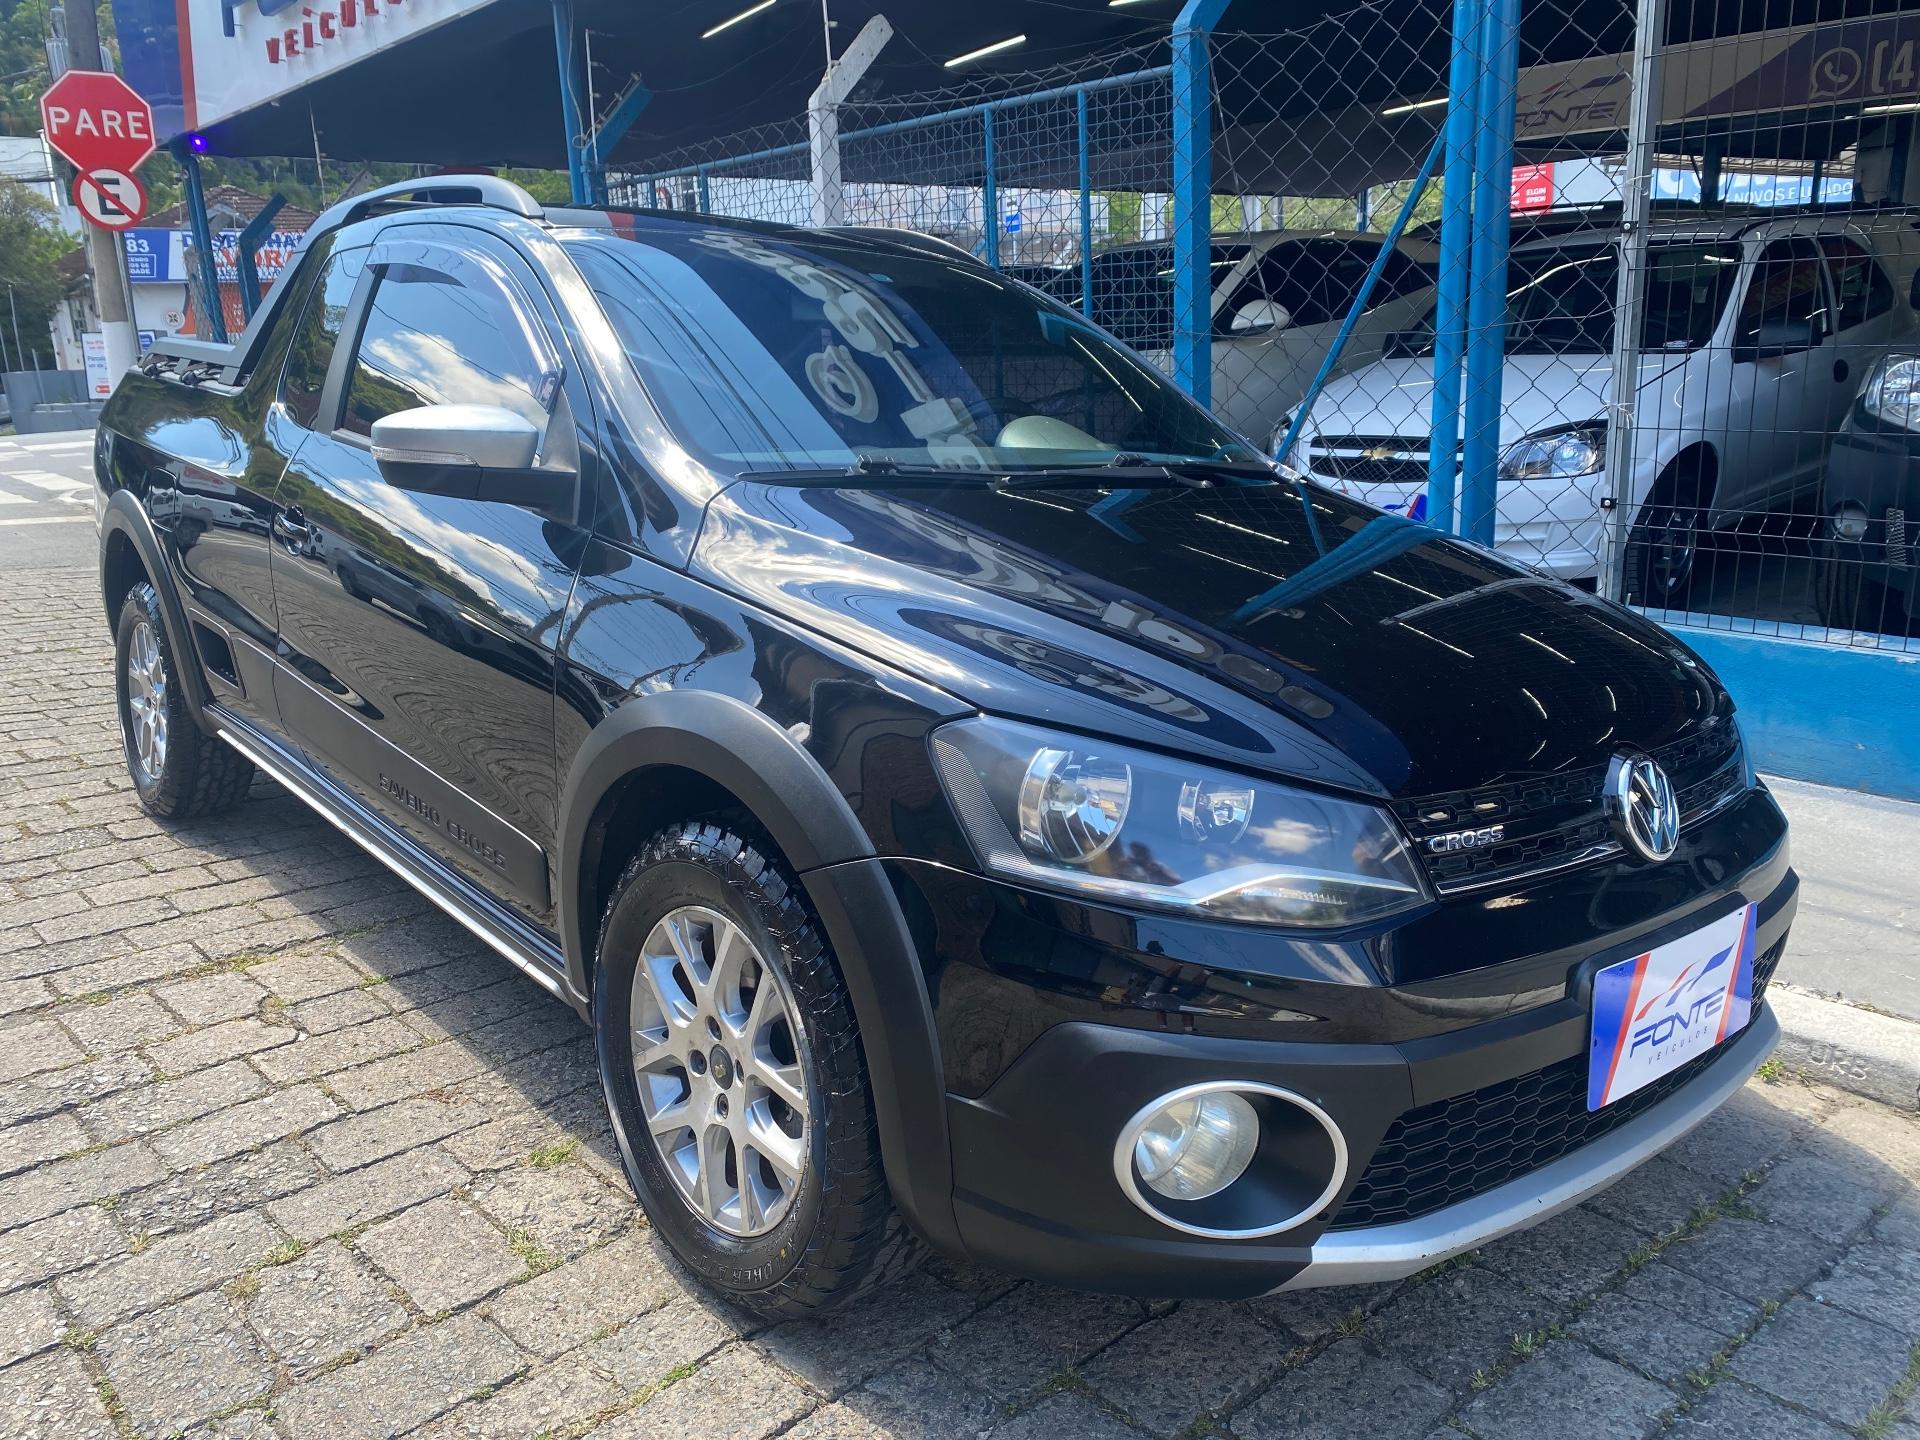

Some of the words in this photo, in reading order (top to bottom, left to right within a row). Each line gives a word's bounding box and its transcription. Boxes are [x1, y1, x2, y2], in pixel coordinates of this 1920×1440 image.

[265, 0, 402, 63] VEÍCUL
[48, 106, 148, 139] PARE
[1800, 182, 1853, 199] UADO
[1428, 825, 1504, 852] CROSS
[1629, 985, 1727, 1058] FONTE
